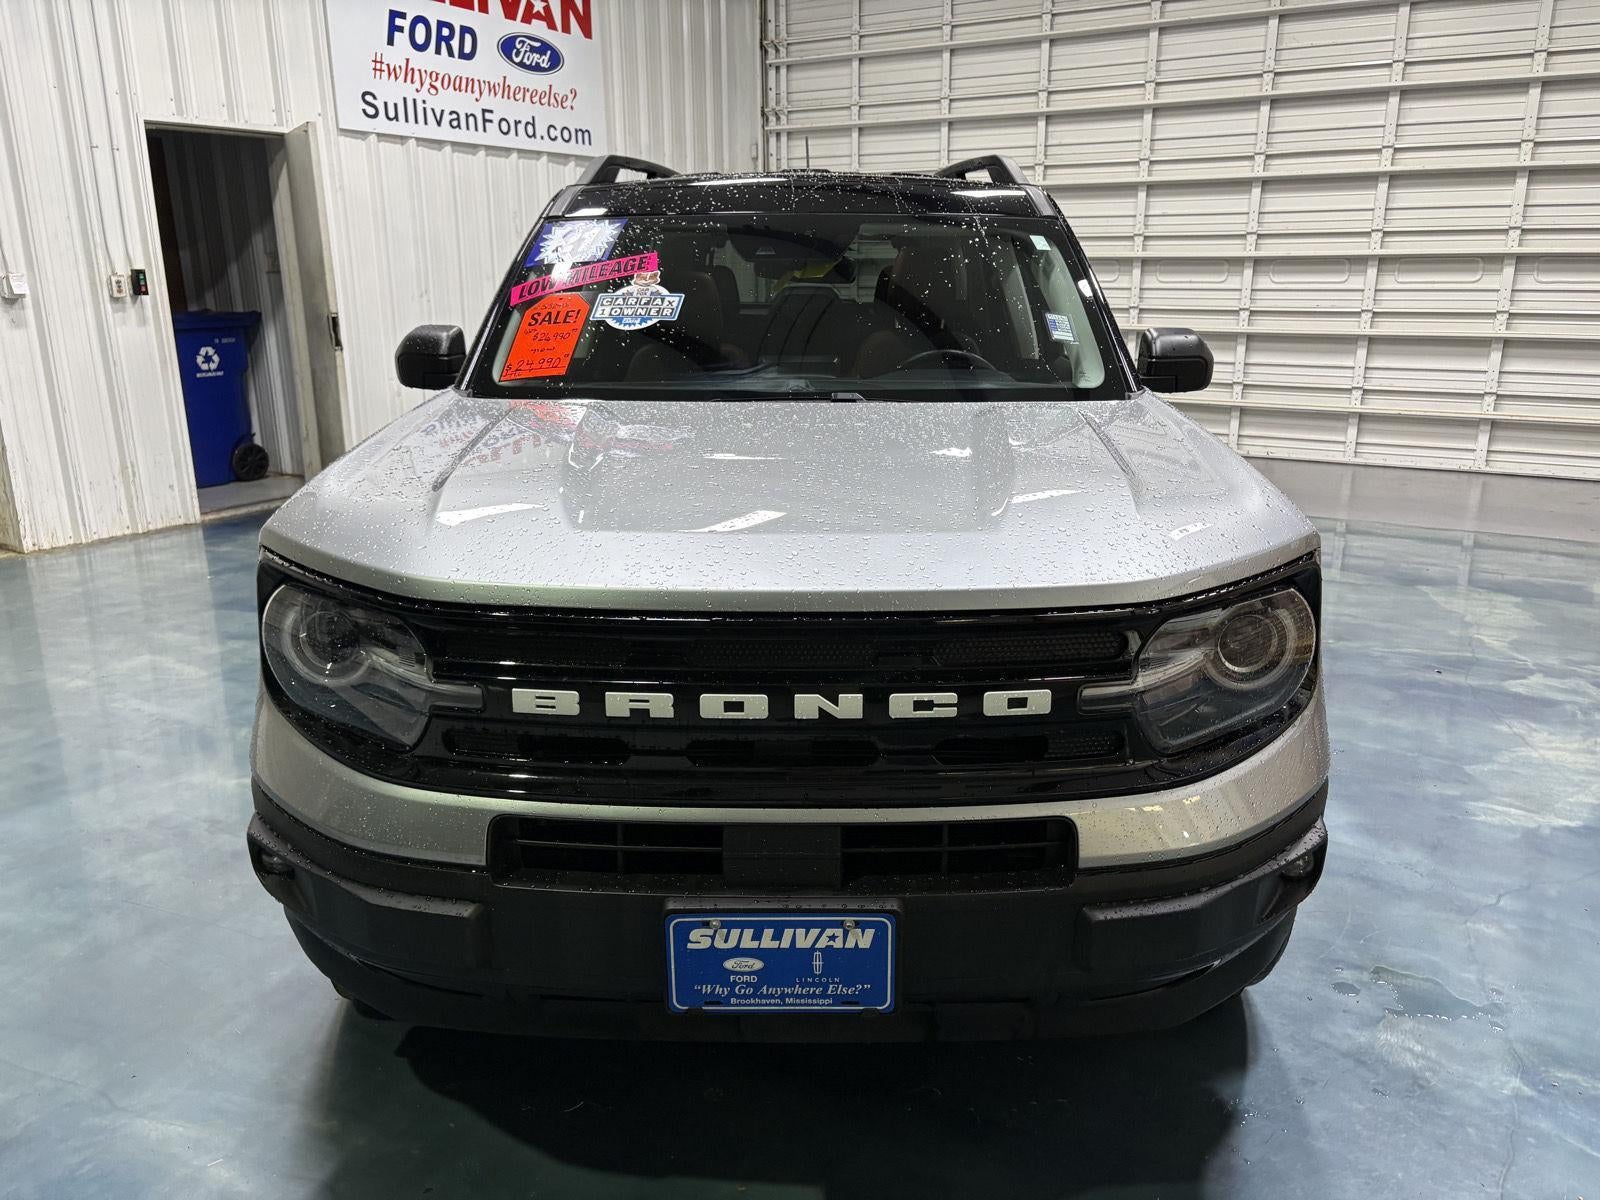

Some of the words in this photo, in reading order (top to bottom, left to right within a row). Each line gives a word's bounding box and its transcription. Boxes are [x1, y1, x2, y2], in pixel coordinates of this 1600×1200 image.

[386, 8, 478, 61] FORD
[511, 37, 551, 69] Ford
[371, 51, 577, 111] #whygoanywhereelse?
[360, 90, 592, 146] SullivanFord.com
[518, 276, 557, 300] LOW
[562, 256, 649, 287] MILEAGE
[602, 297, 677, 307] CARFAX
[527, 308, 581, 326] SALE!
[611, 308, 673, 316] OWNER
[511, 687, 1052, 720] BRONCO
[686, 928, 876, 949] SULLIVAN
[731, 960, 755, 970] Ford
[730, 975, 757, 983] FORD
[735, 984, 754, 995] Go
[757, 984, 823, 997] Anywhere
[730, 997, 783, 1006] Brookhaven,
[785, 997, 833, 1007] Mississippi
